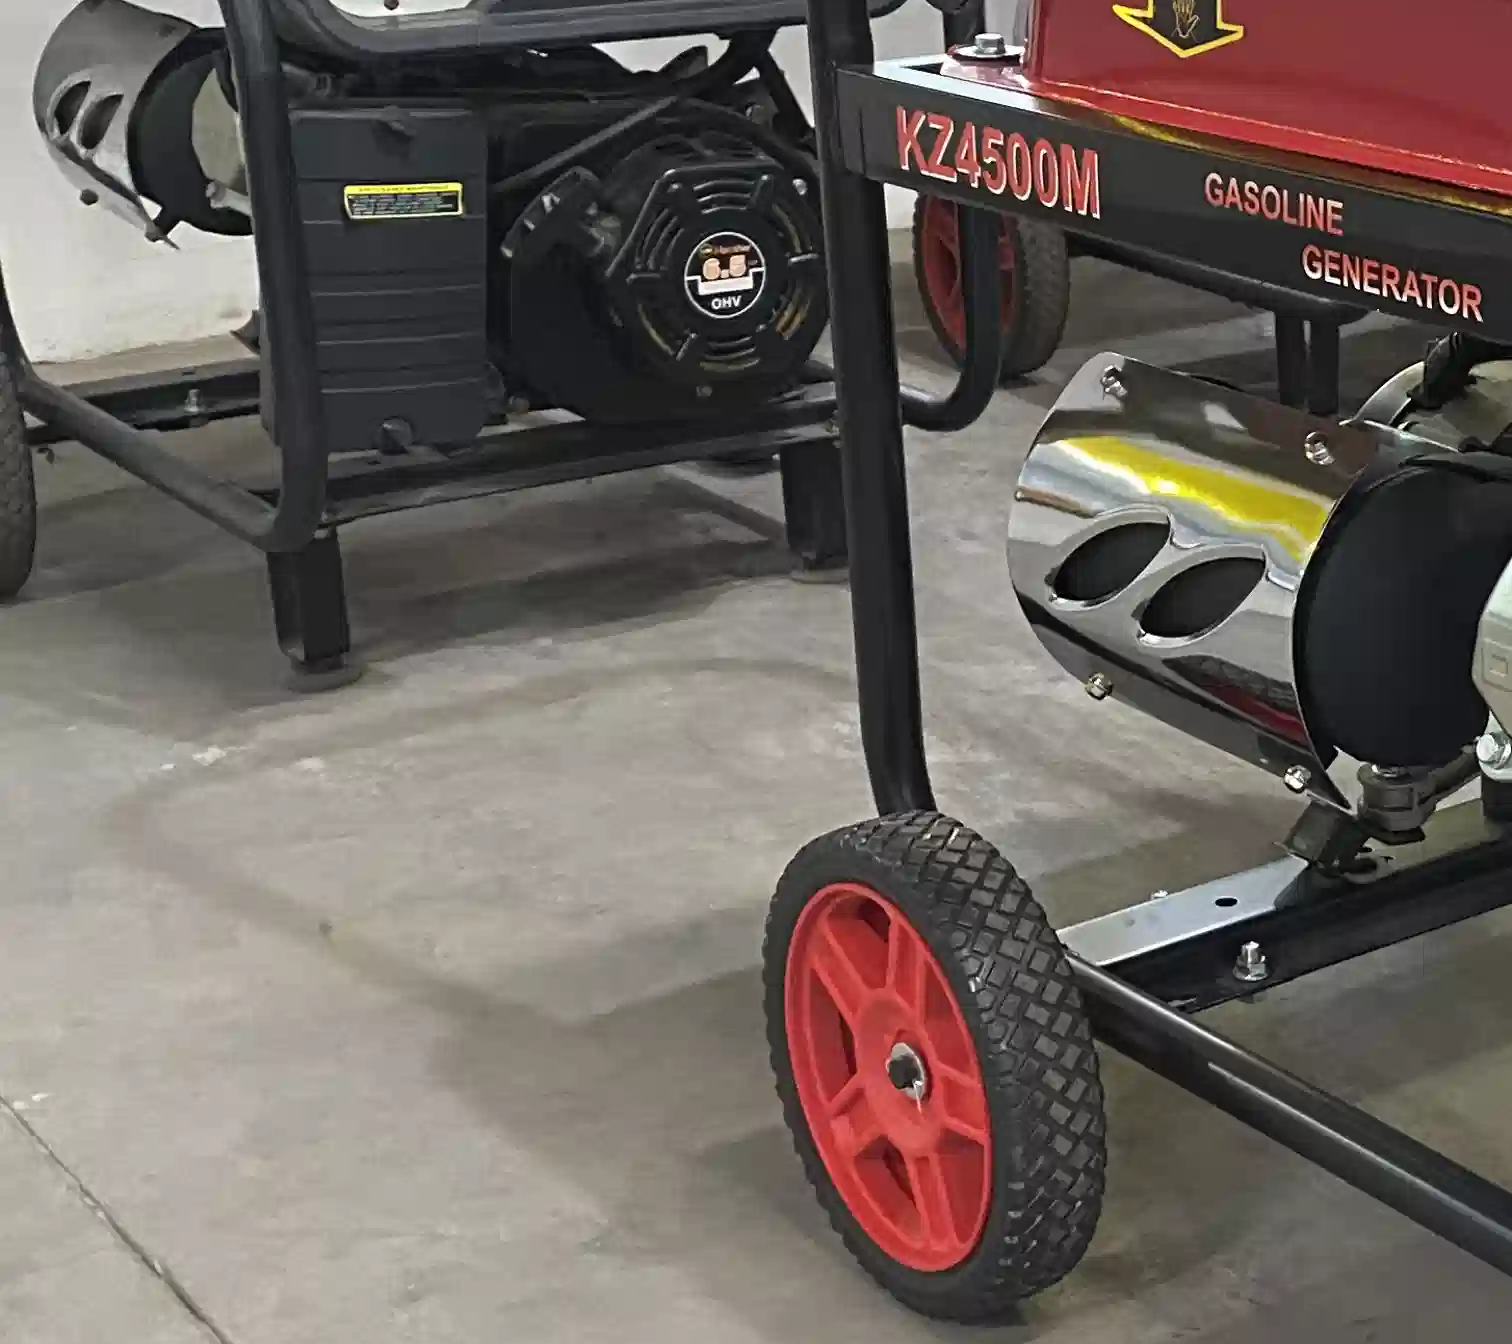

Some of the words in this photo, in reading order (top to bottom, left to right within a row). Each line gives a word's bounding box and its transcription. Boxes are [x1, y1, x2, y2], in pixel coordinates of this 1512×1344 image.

[896, 104, 1101, 220] KZ4500M
[1204, 171, 1344, 237] GASOLINE
[710, 295, 743, 311] OHV
[1301, 243, 1485, 324] GENERATOR
